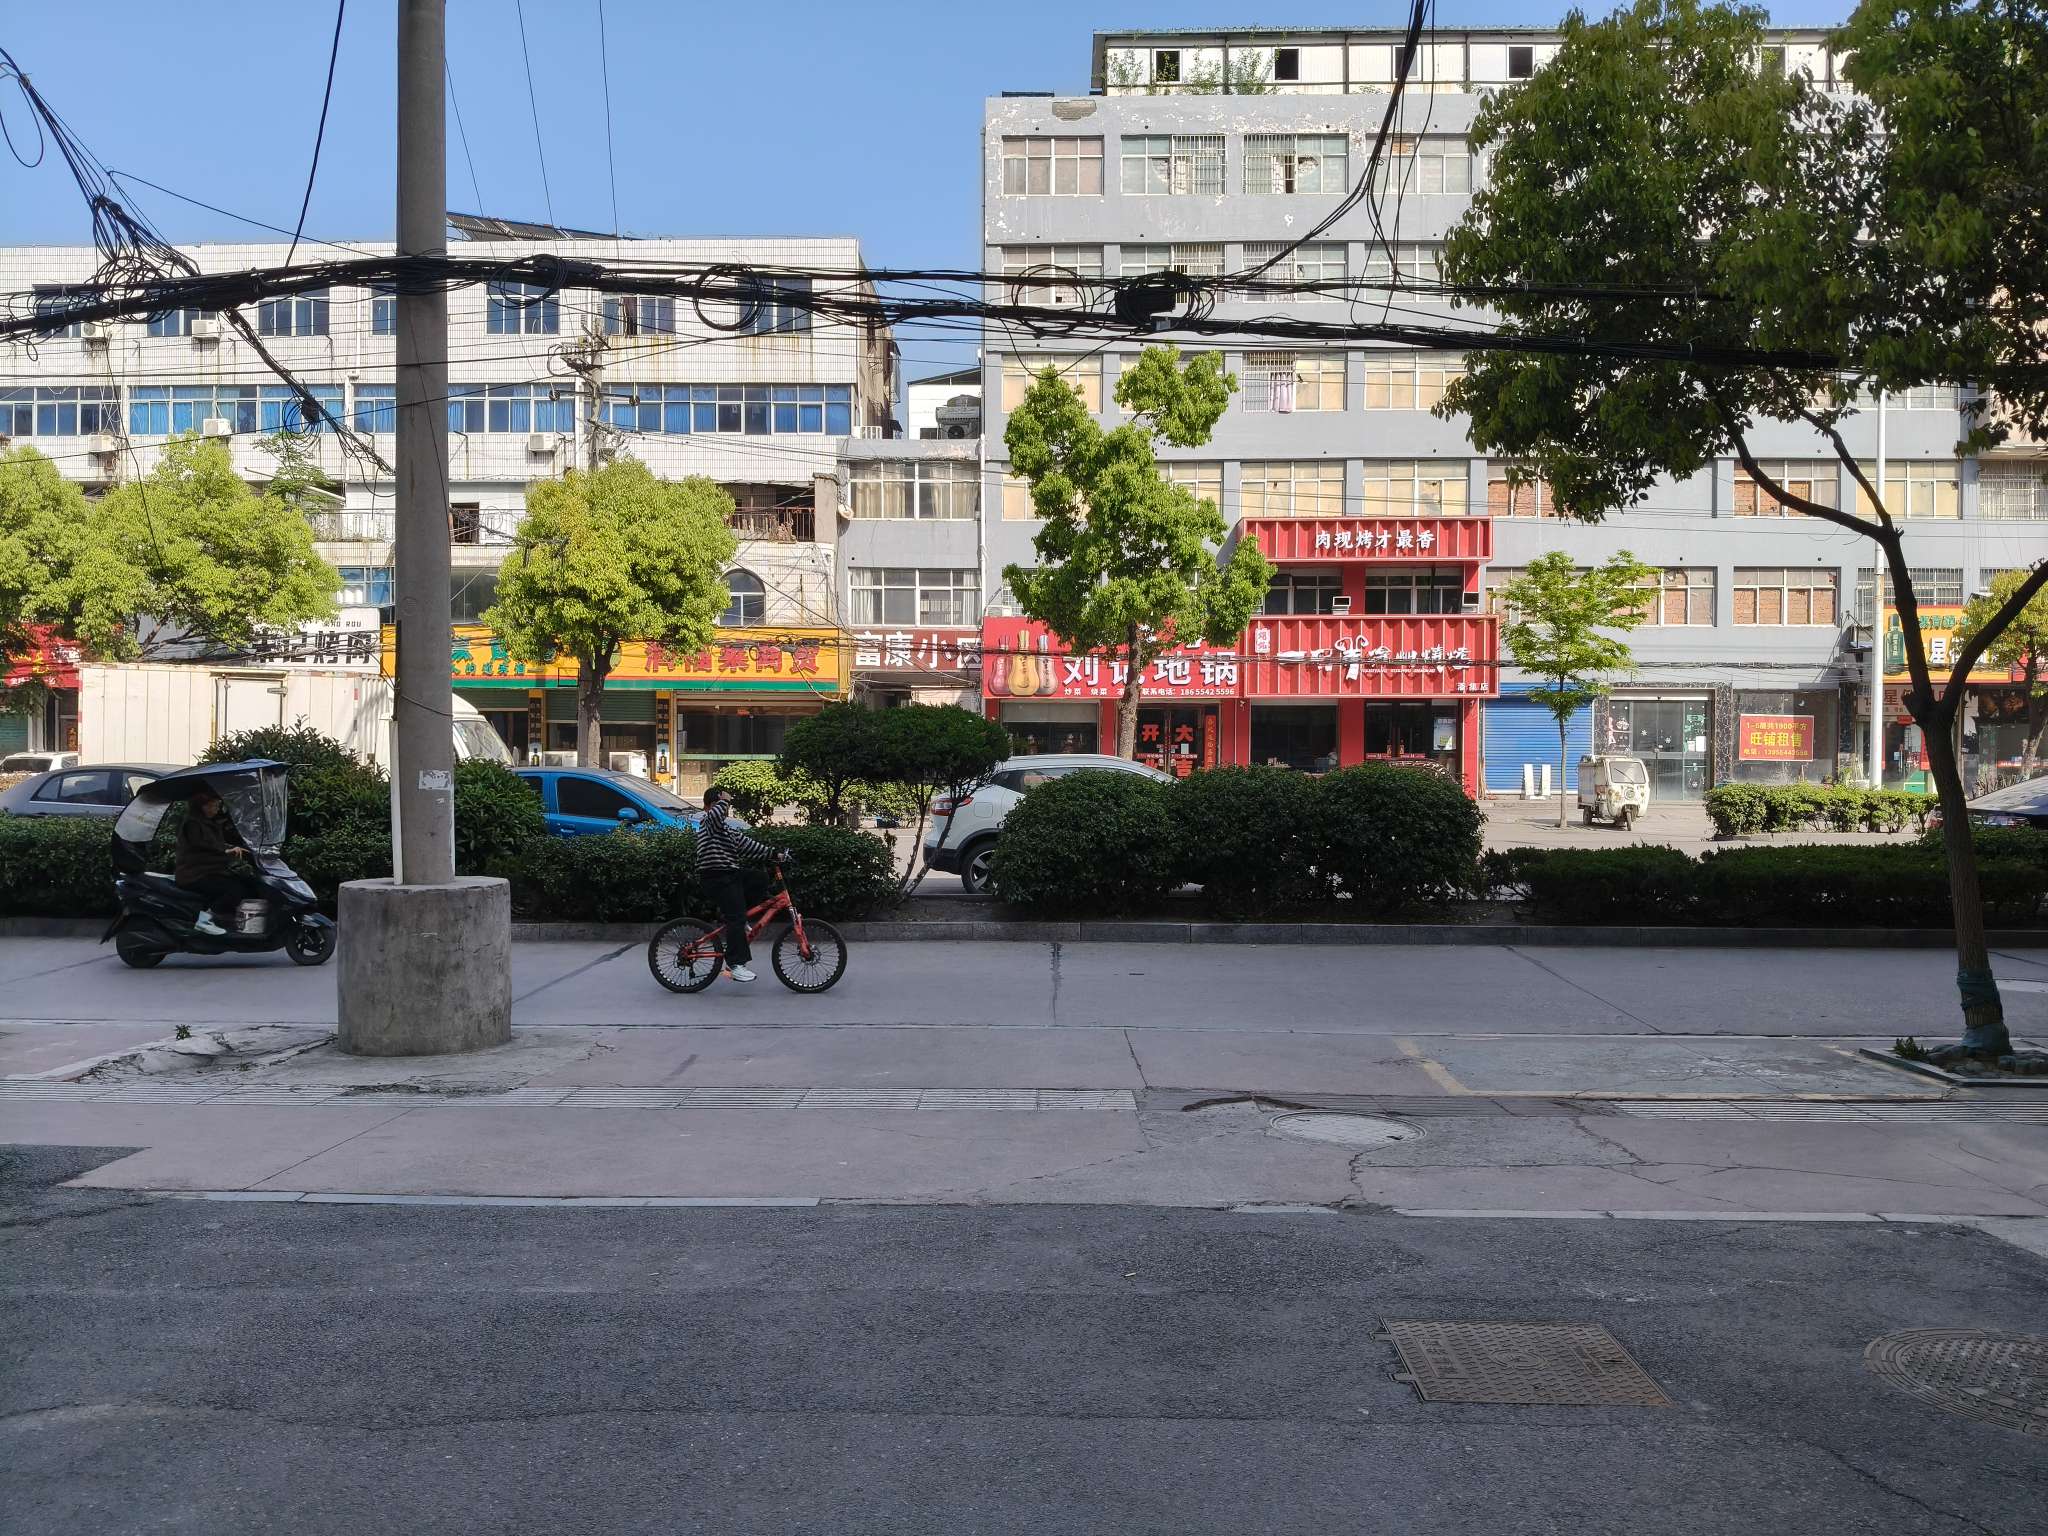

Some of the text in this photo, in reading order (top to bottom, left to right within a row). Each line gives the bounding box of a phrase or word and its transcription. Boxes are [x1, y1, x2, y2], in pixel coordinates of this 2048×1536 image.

[1315, 530, 1436, 549] 肉现烤才最香
[853, 631, 981, 668] 富康小区
[1750, 731, 1802, 747] 旺铺租售
